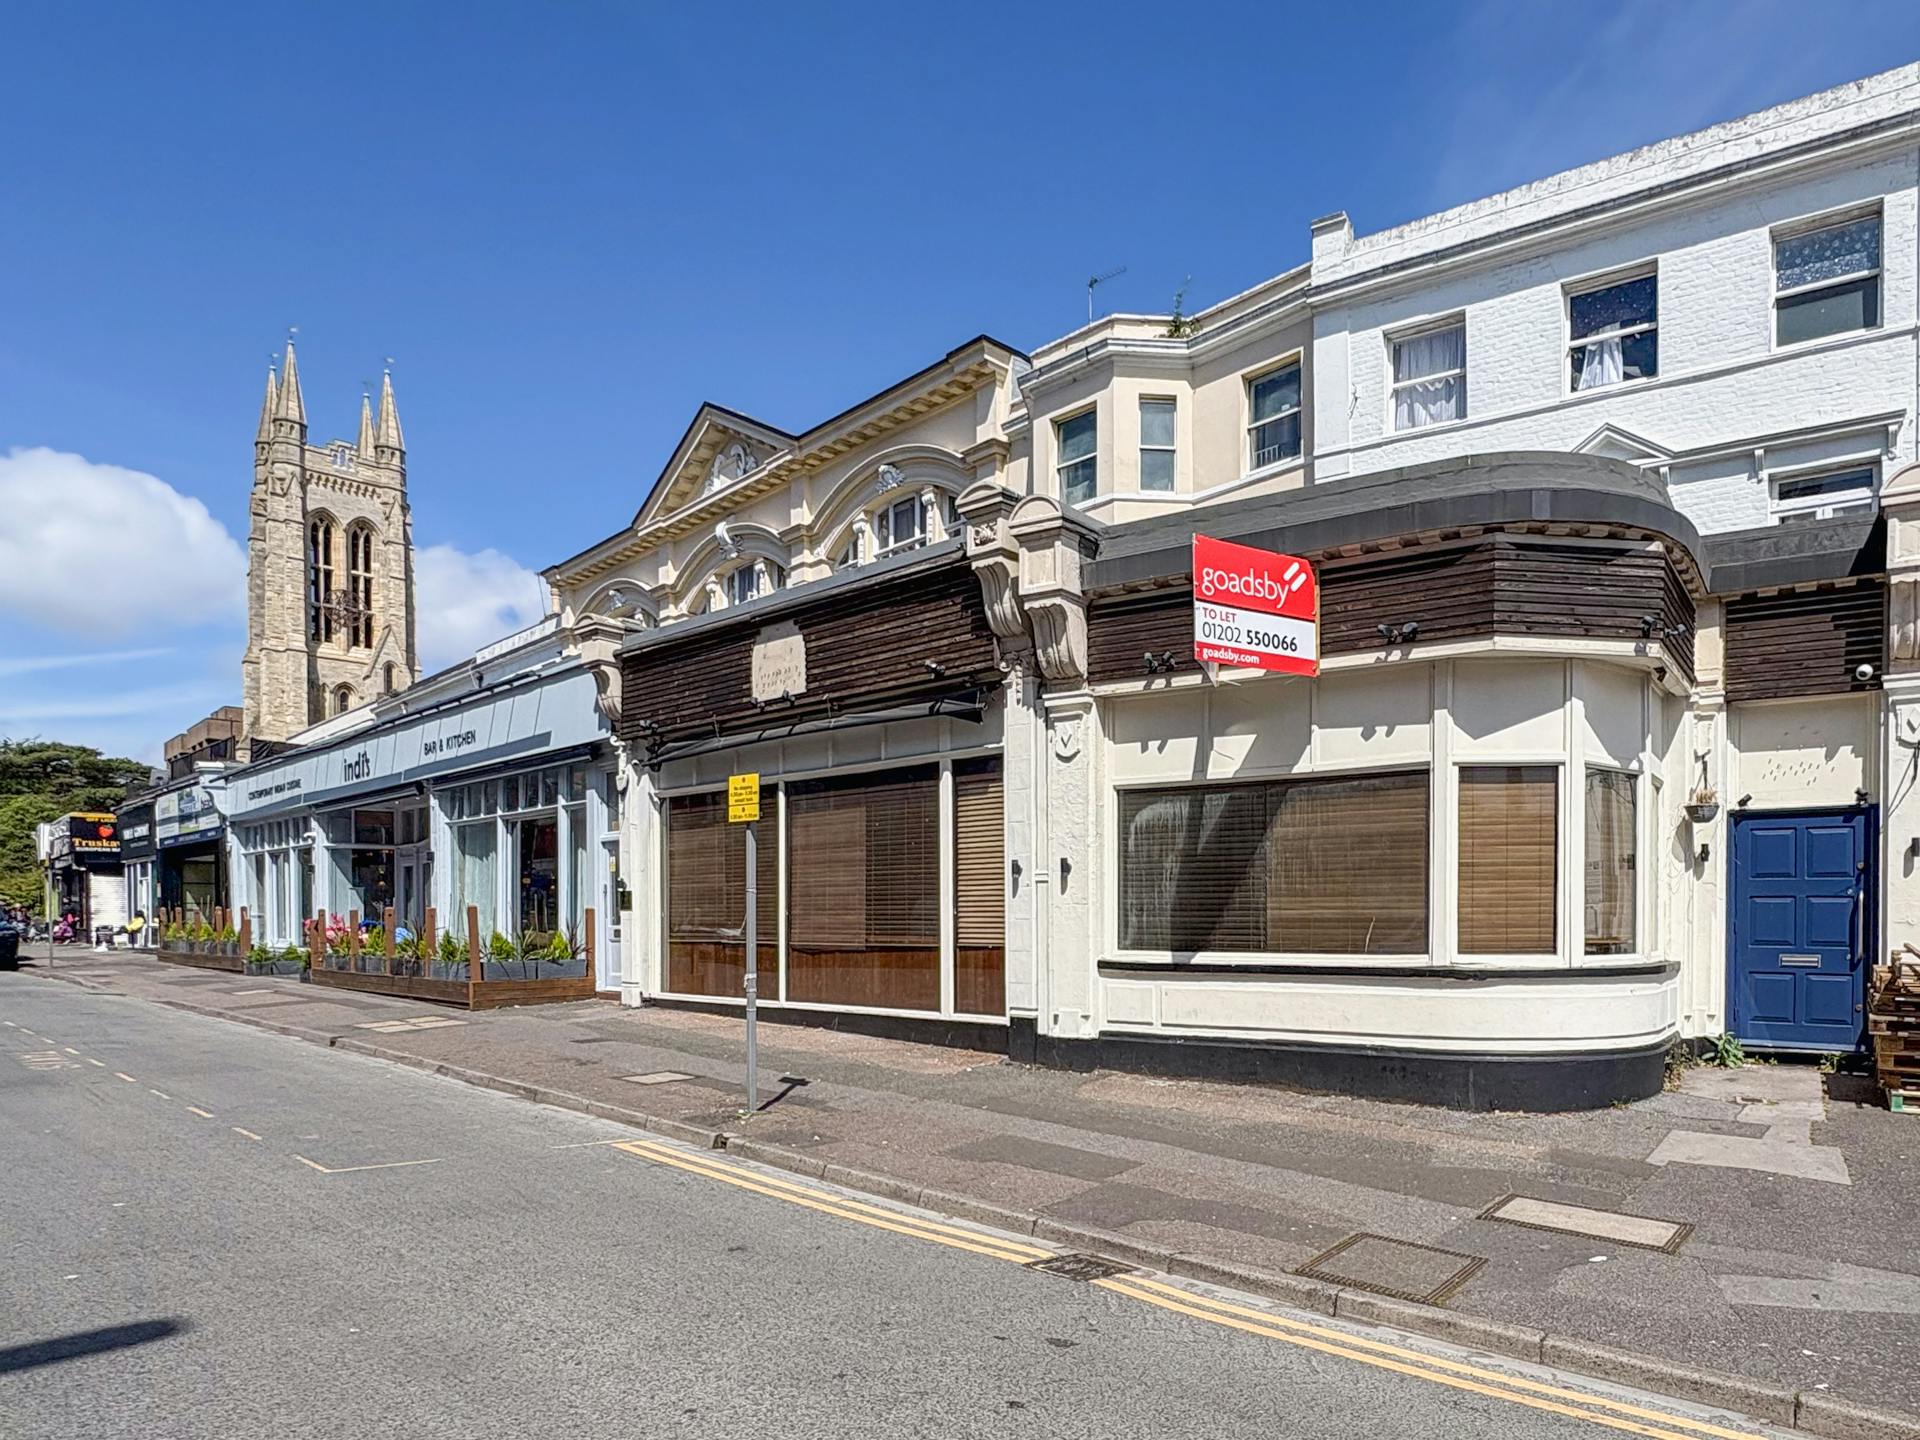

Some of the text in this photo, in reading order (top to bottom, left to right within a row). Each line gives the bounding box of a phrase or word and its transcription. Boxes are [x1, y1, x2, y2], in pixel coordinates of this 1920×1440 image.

[1202, 568, 1289, 608] goadsby
[1202, 607, 1237, 622] TO LET
[1202, 621, 1298, 652] 01202 550066
[1202, 648, 1260, 665] goadsby.com
[424, 730, 477, 756] BAR & KITCHEN
